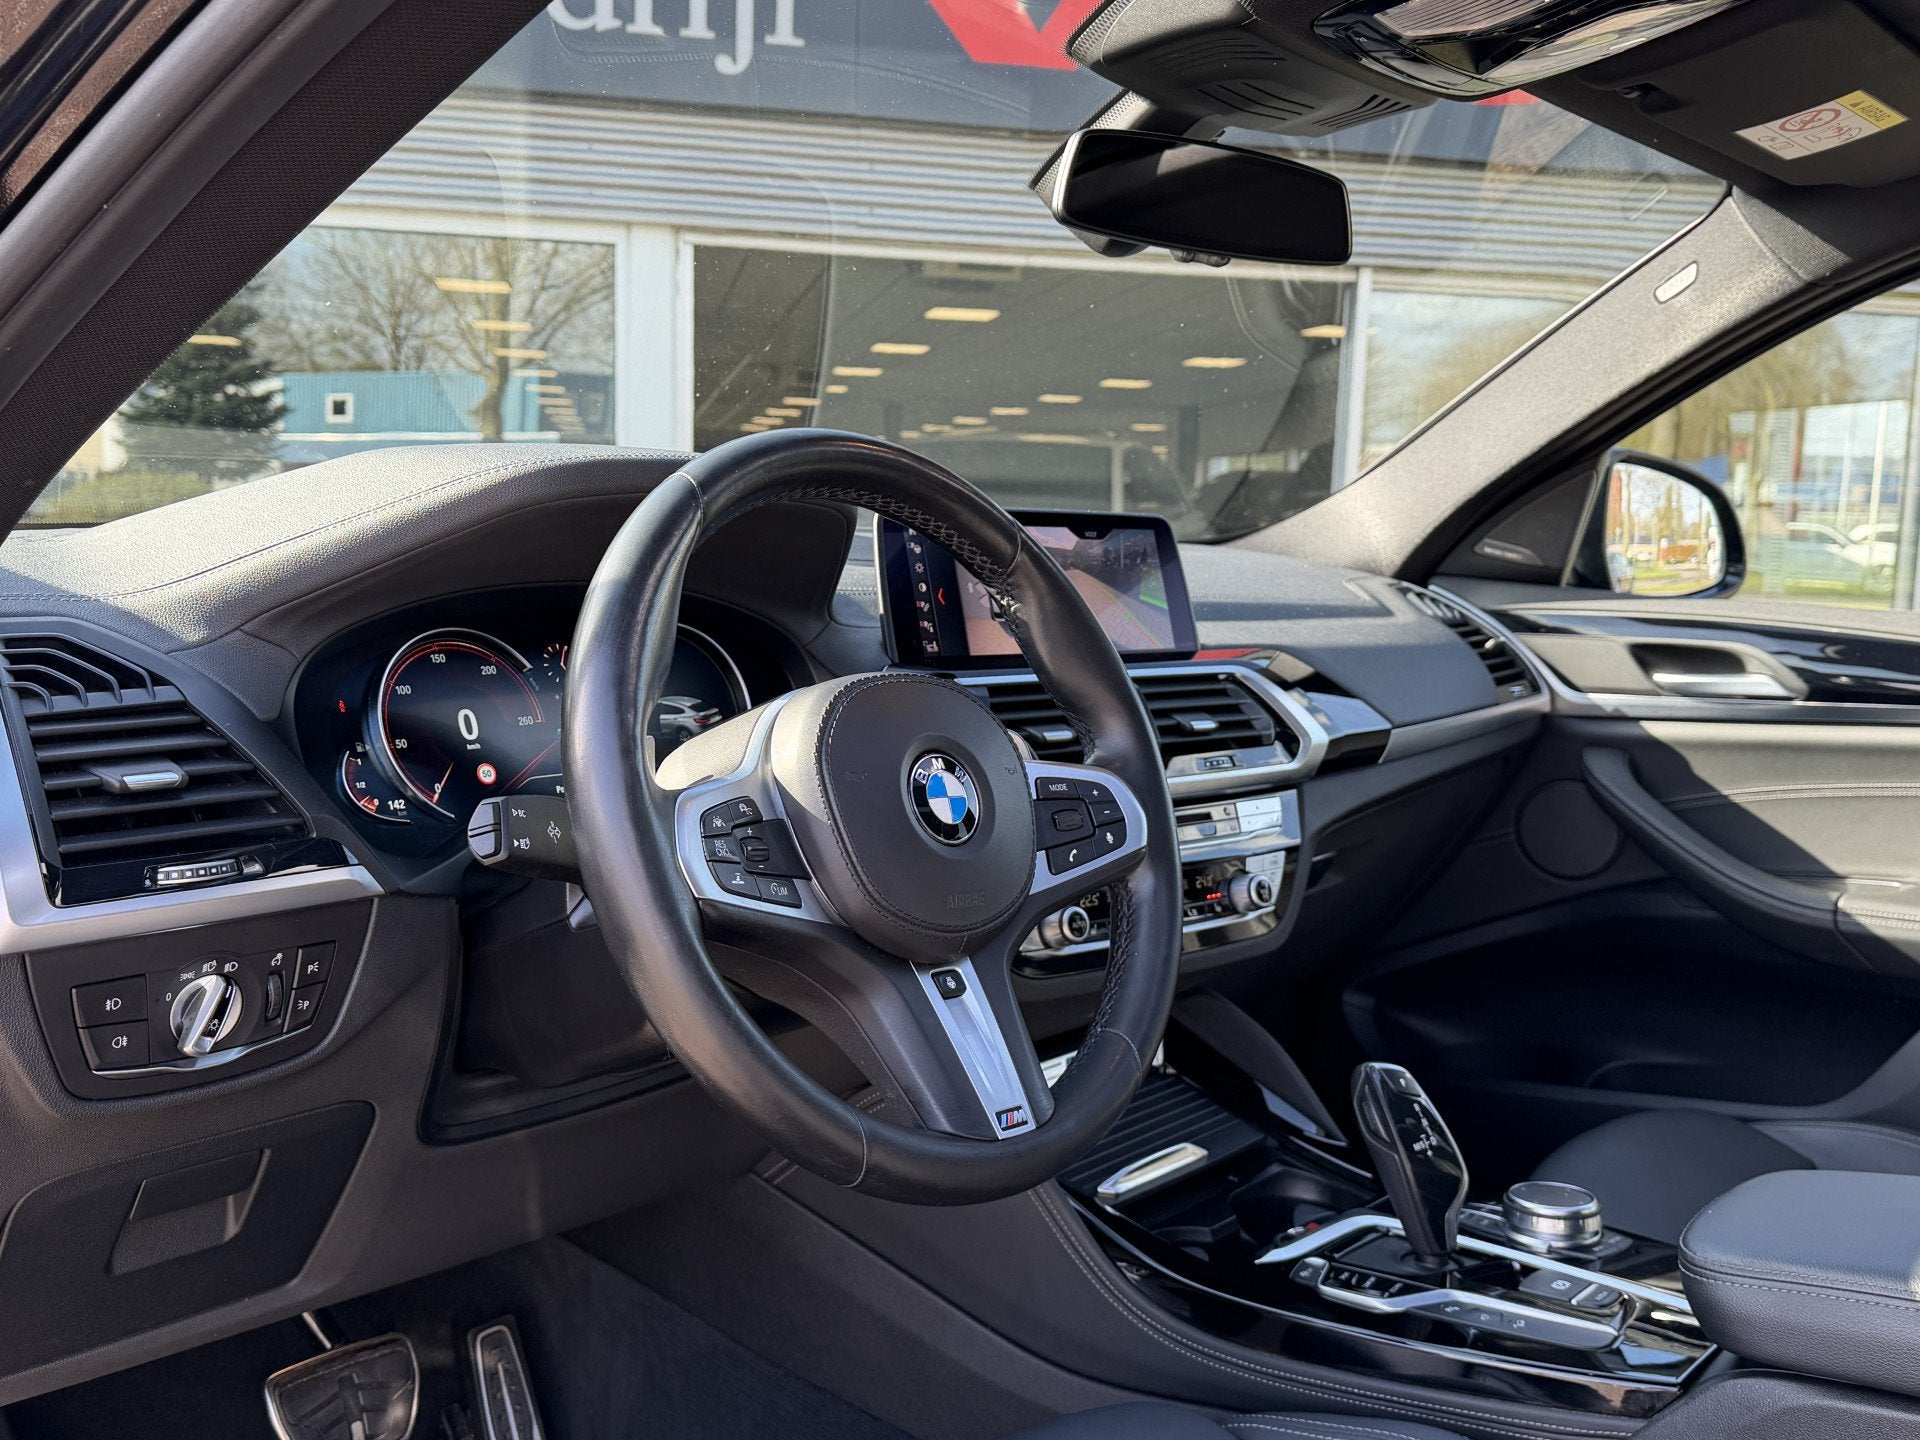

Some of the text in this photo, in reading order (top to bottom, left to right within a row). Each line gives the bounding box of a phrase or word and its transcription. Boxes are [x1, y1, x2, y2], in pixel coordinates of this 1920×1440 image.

[430, 653, 446, 664] 150
[480, 665, 497, 675] 200
[395, 684, 412, 695] 100
[457, 708, 479, 741] 0
[517, 716, 534, 726] 260
[395, 738, 408, 749] 50
[482, 769, 492, 779] 50
[915, 757, 967, 785] BMW
[1048, 783, 1069, 792] MODE
[387, 799, 406, 811] 142
[307, 964, 314, 975] P
[303, 1000, 310, 1010] P
